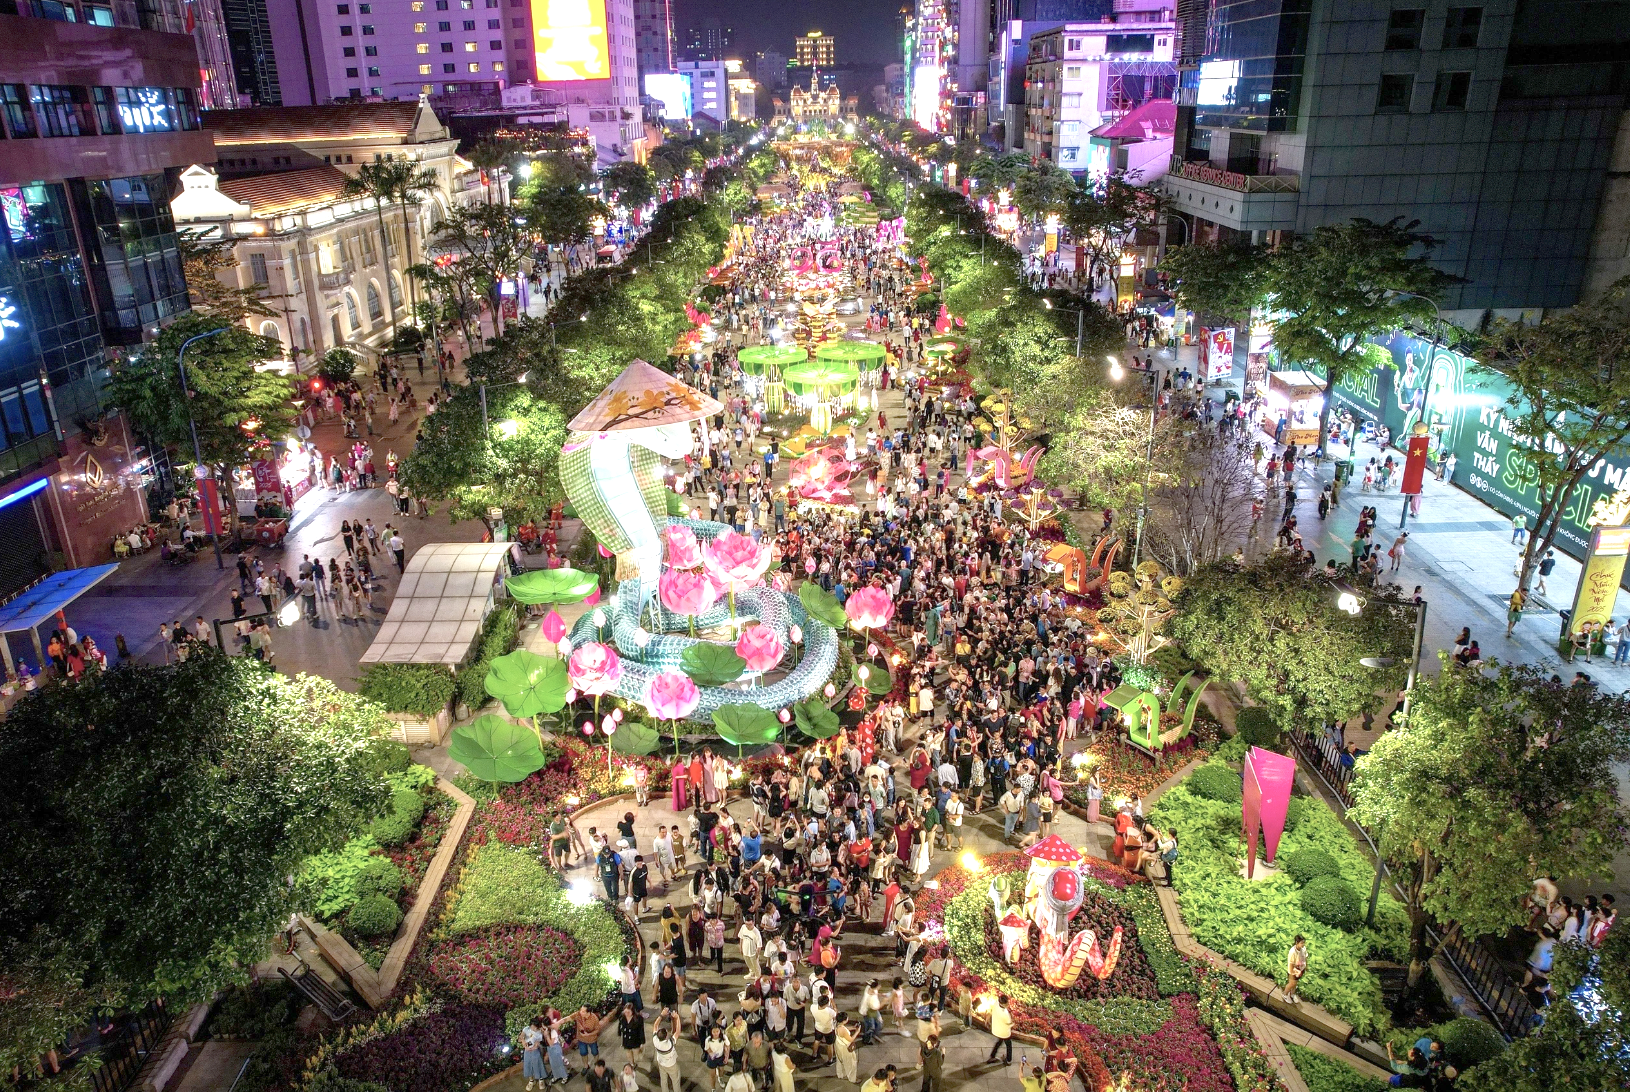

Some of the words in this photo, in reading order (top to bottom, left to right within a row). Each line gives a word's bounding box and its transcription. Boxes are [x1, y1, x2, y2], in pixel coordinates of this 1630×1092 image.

[1184, 163, 1199, 178] OFFICE
[1200, 166, 1221, 184] SERVICE
[1222, 170, 1244, 189] CENTER
